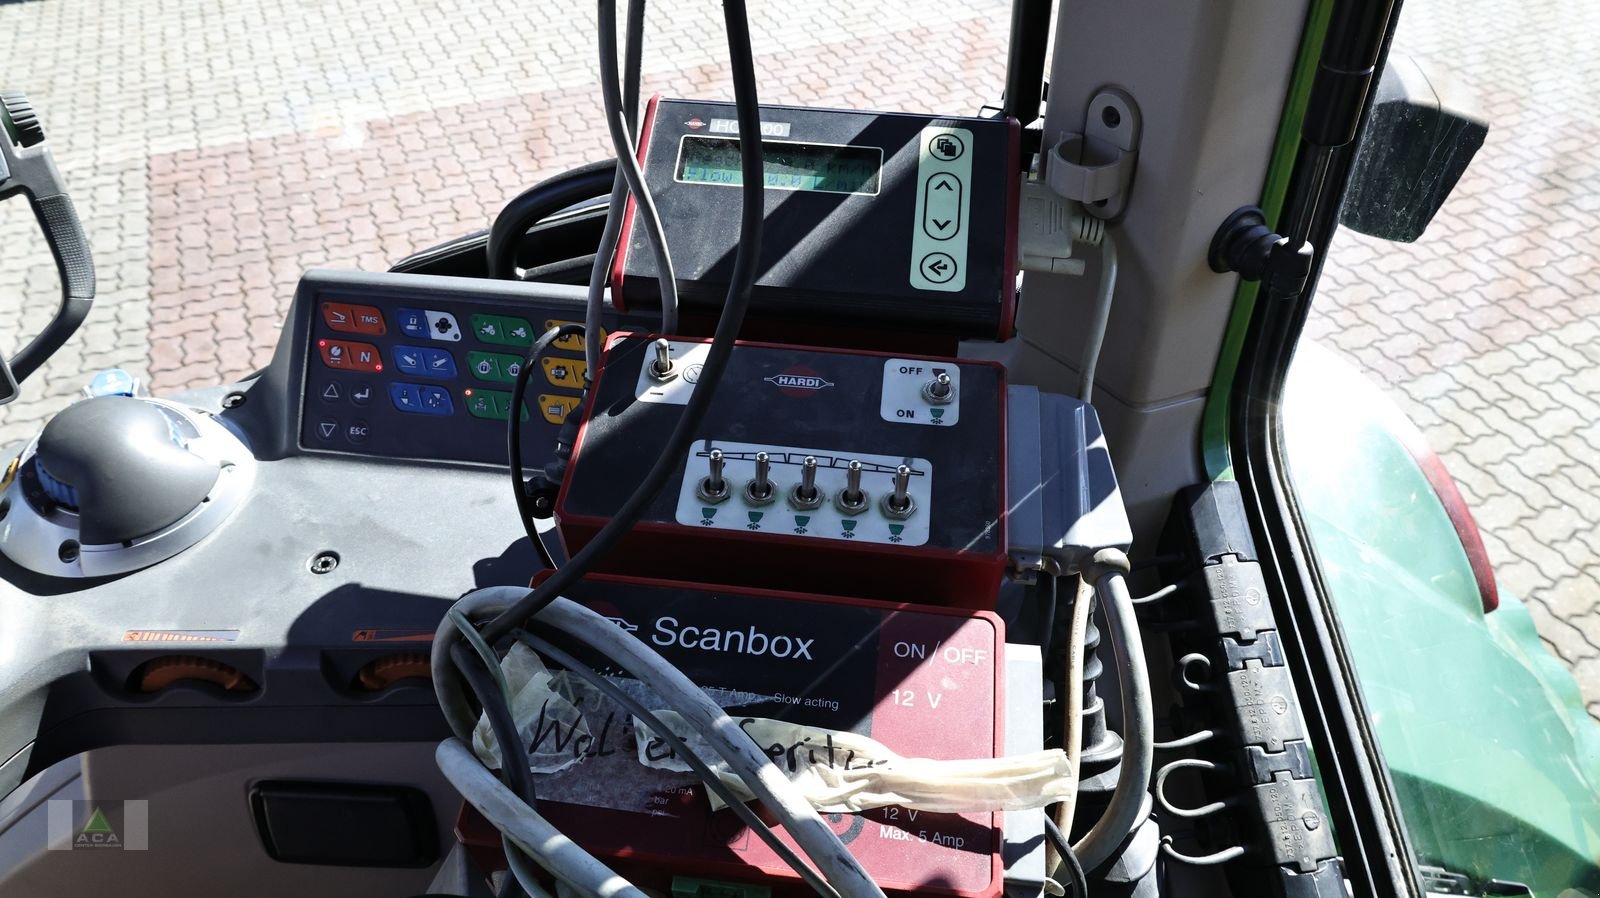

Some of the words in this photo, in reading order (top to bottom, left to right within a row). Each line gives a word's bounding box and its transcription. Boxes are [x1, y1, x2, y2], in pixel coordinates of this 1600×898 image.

[688, 167, 733, 182] Flow
[360, 315, 379, 324] TMS
[360, 351, 371, 363] N
[899, 366, 923, 375] OFF
[778, 376, 820, 387] HARDI
[896, 409, 915, 418] ON
[349, 426, 367, 436] ESC
[651, 616, 815, 661] Scanbox
[893, 641, 926, 659] ON
[943, 646, 988, 665] OFF
[774, 692, 801, 705] Slow
[804, 696, 840, 711] acting
[891, 688, 915, 707] 12
[927, 691, 942, 709] V
[678, 787, 693, 797] mA
[654, 796, 670, 805] bar
[882, 806, 899, 820] 12
[907, 809, 919, 822] V
[879, 825, 913, 841] Max.
[918, 830, 928, 843] 5
[932, 831, 965, 850] Amp
